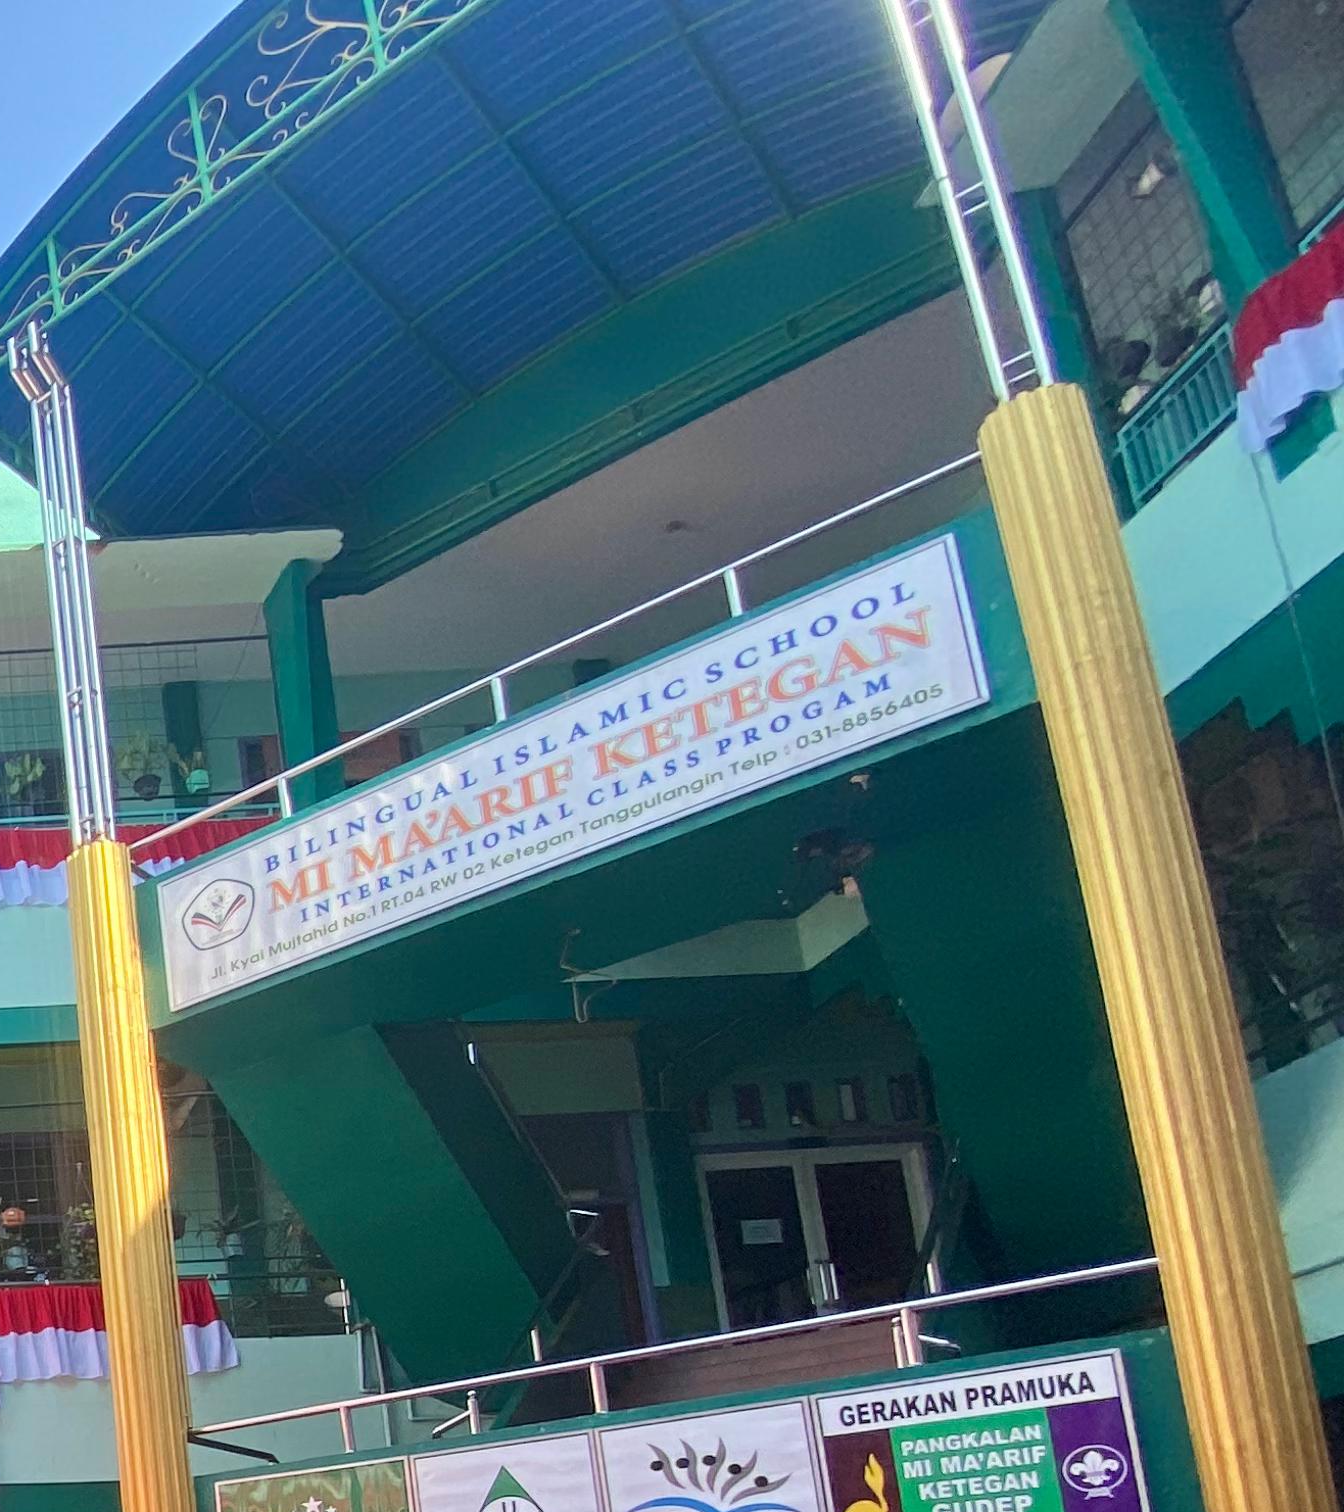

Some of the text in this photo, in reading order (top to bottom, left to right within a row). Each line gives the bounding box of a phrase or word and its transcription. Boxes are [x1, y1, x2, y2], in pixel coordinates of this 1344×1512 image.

[265, 583, 916, 874] BILINGUAL ISLAMIC SCHOOL
[266, 858, 335, 914] MI
[587, 605, 932, 781] KETEGAN
[300, 673, 892, 923] INTERNATIONAL CLASS PROGAM
[230, 952, 265, 973] Kyai
[269, 920, 339, 958] Mujtahid
[380, 882, 425, 914] RT.04
[430, 872, 458, 894] RW
[462, 861, 486, 881] 02
[490, 829, 574, 869] Ketegan
[579, 769, 724, 835] Tanggulangin
[729, 750, 777, 776] Telp
[796, 683, 944, 750] 031-8856405
[839, 1371, 1096, 1427] GERAKAN PRAMUKA
[900, 1424, 1043, 1456] PANGKALAN
[902, 1459, 933, 1479] MI
[918, 1471, 1040, 1500] KETEGAN
